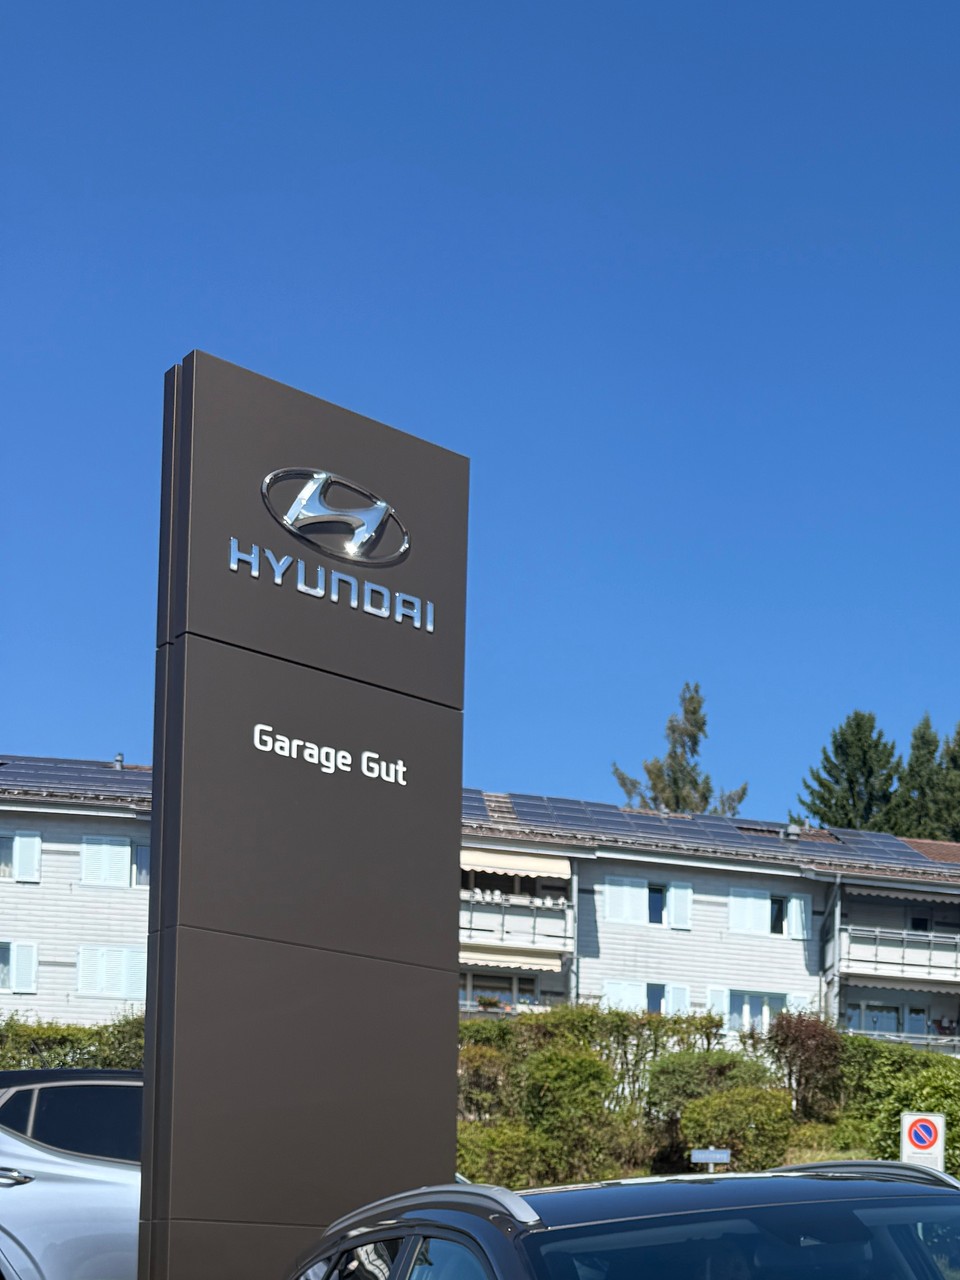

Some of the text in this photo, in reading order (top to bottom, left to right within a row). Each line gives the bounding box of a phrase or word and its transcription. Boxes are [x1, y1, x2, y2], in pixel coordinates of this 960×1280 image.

[229, 535, 436, 633] HYUNDAI
[254, 722, 408, 786] Garage Gut
